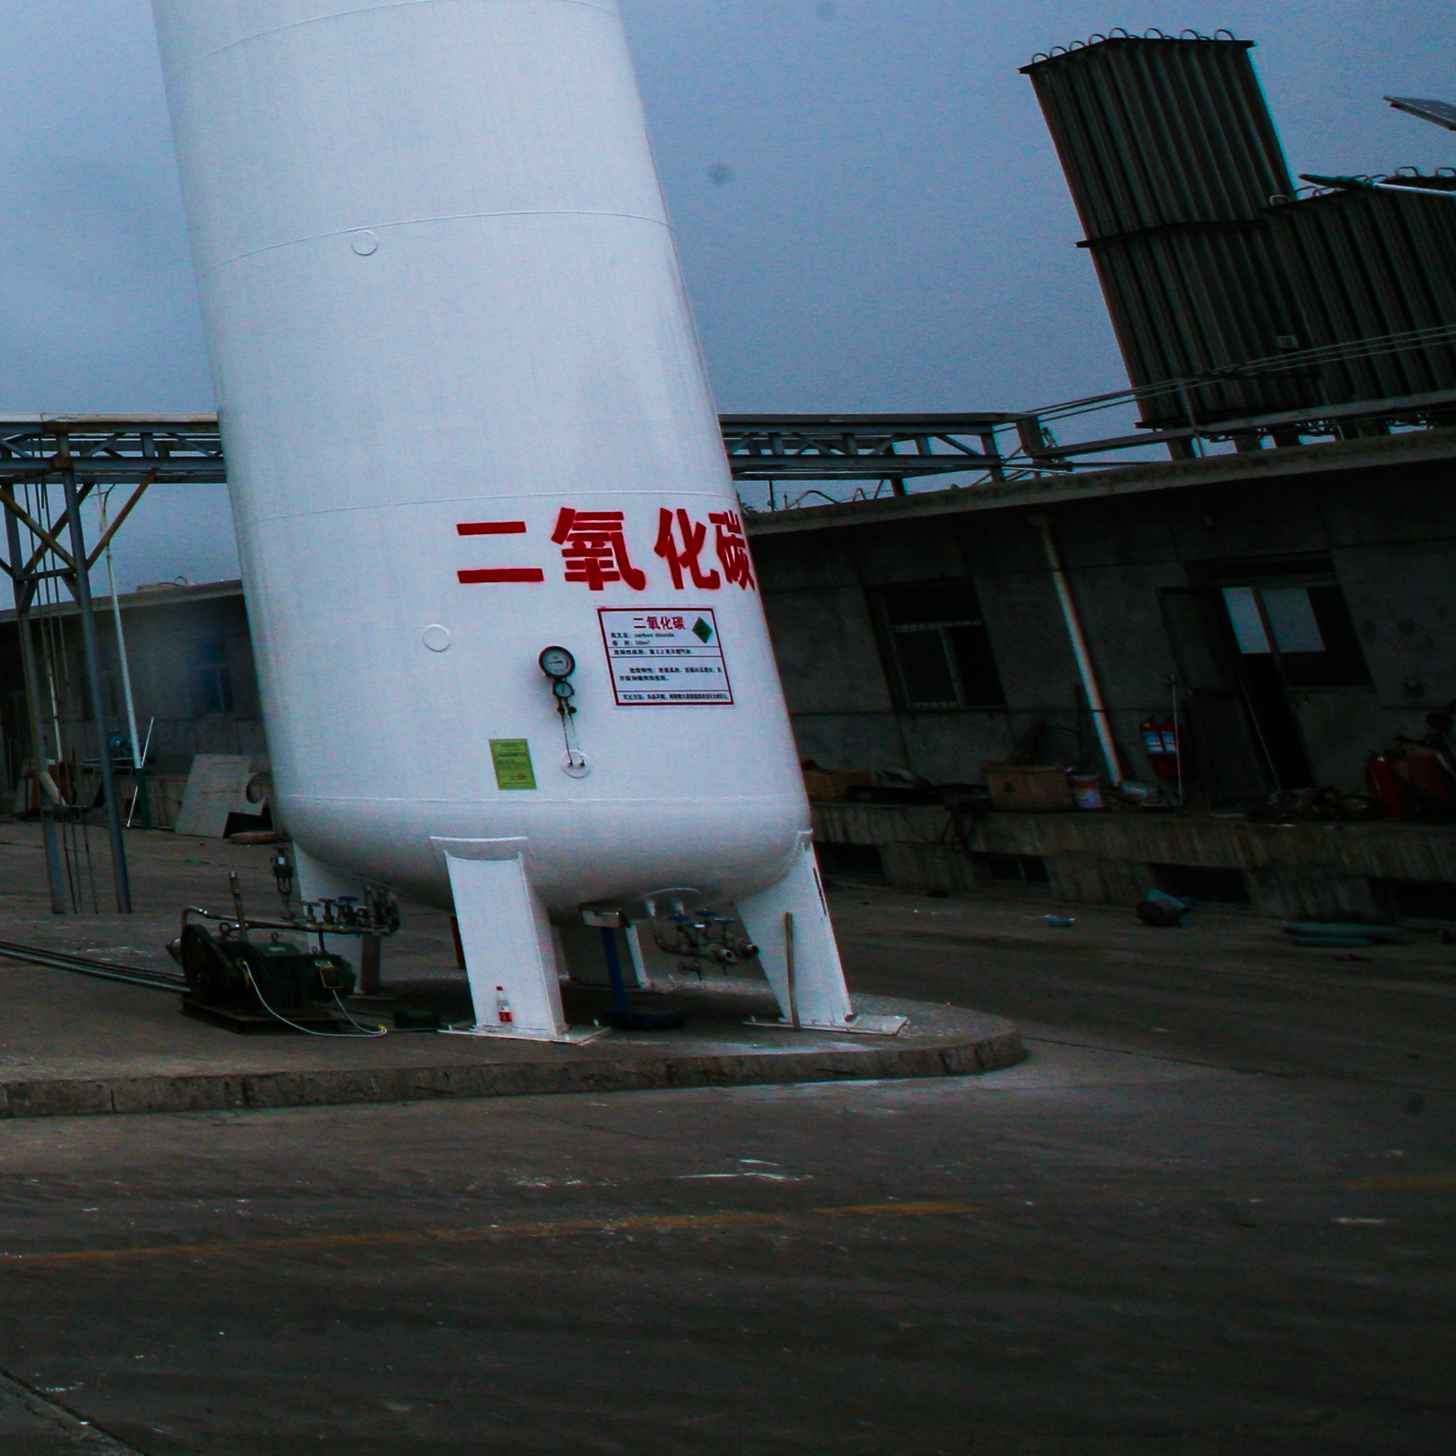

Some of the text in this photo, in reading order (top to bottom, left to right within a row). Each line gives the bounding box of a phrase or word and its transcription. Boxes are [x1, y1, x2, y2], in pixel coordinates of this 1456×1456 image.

[456, 507, 756, 591] 二氧化碳
[633, 615, 686, 630] 二氧化碳
